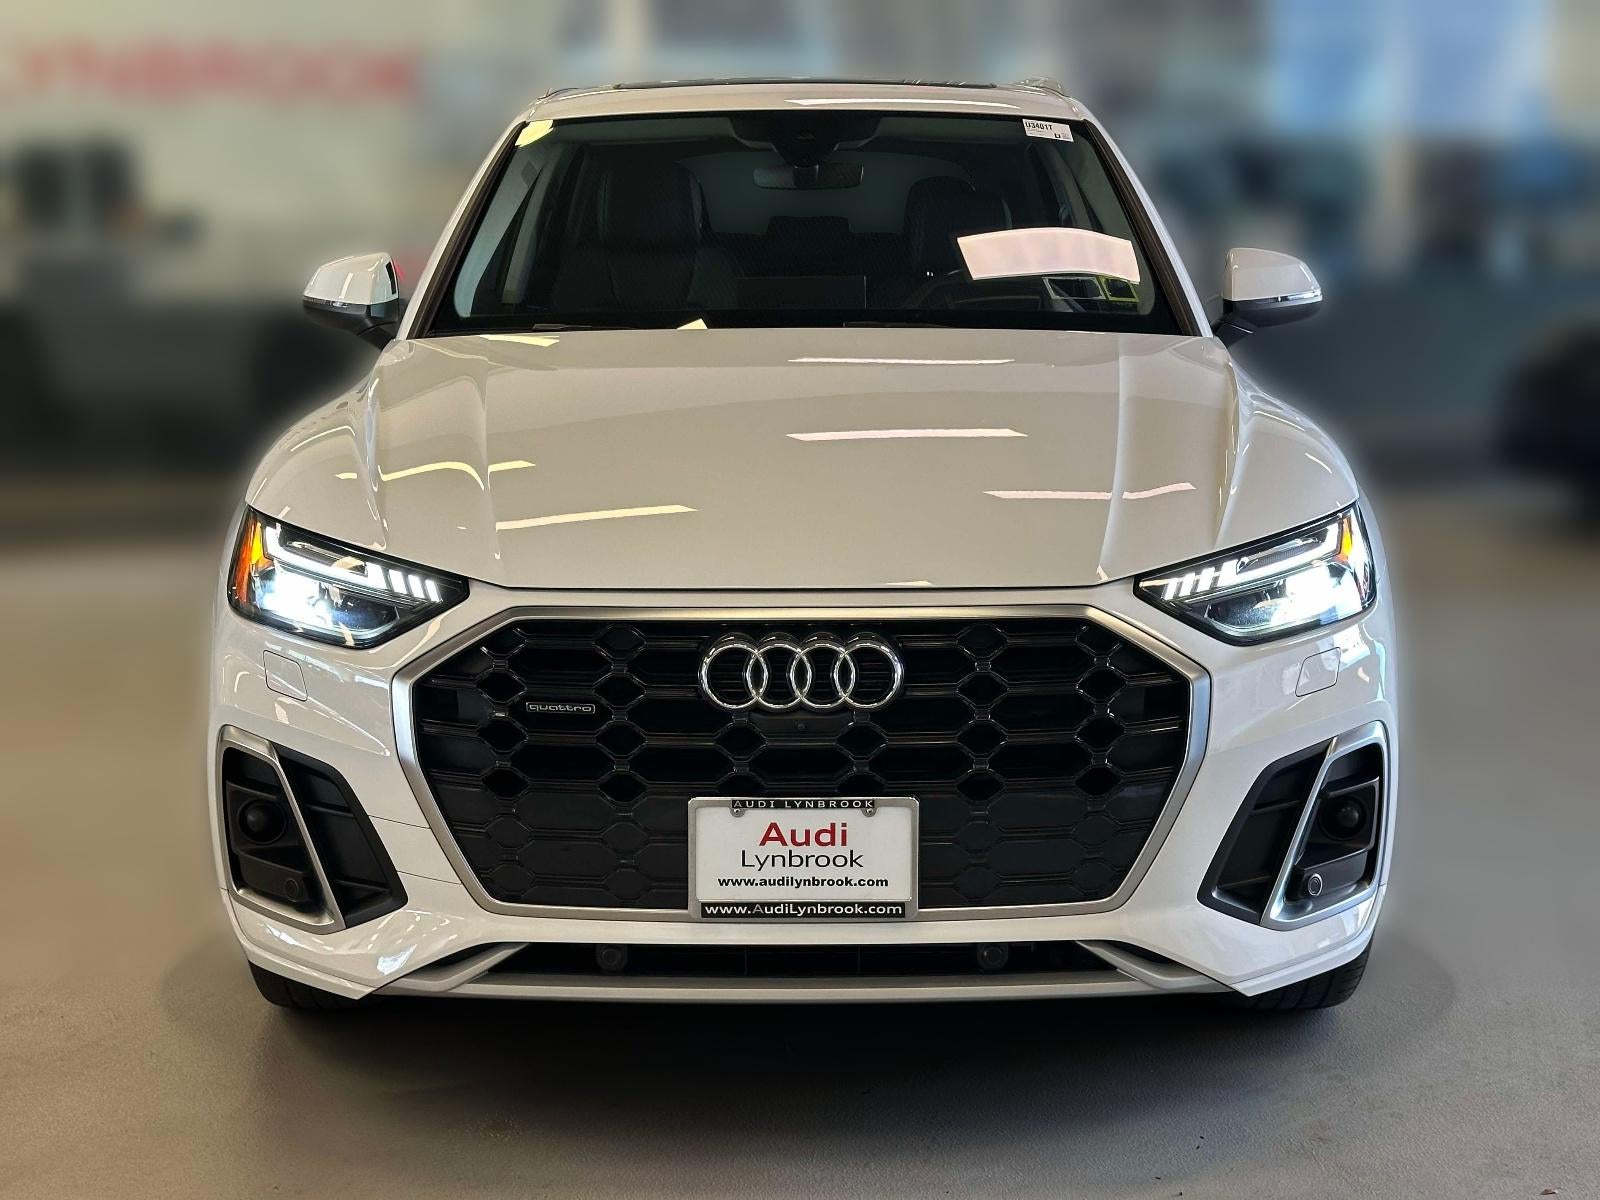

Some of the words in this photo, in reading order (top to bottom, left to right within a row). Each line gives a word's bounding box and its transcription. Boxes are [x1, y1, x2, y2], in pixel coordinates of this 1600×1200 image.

[529, 704, 592, 712] quattro
[733, 800, 775, 808] AUDI
[785, 800, 874, 808] LYNBROOK
[758, 822, 848, 847] Audi
[741, 850, 864, 872] Lynbrook
[718, 876, 889, 889] www.audilynbrook.com
[705, 904, 902, 917] www.AudiLynbrook.com
